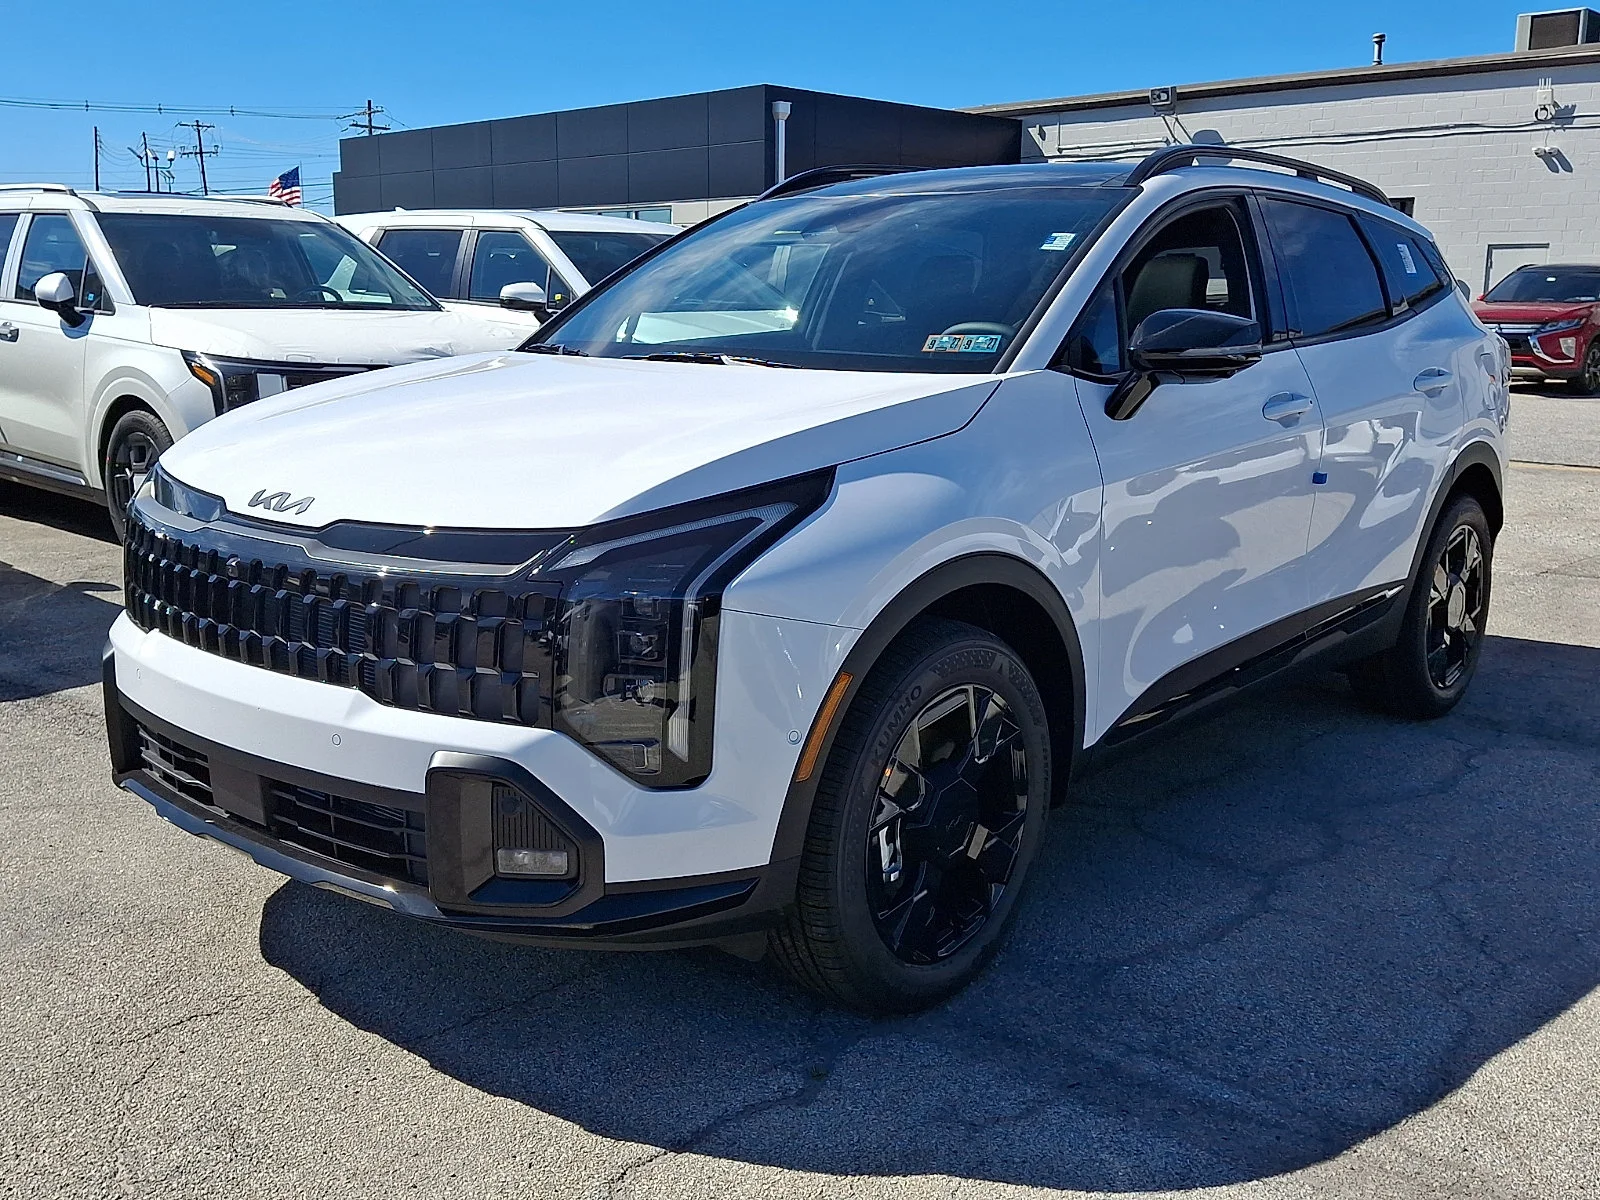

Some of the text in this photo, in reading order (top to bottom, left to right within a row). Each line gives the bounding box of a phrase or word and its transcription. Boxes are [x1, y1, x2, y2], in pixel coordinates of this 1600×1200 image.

[950, 337, 961, 349] 27
[987, 337, 998, 349] 27
[248, 489, 315, 515] KIA
[870, 685, 922, 768] KUMHO
